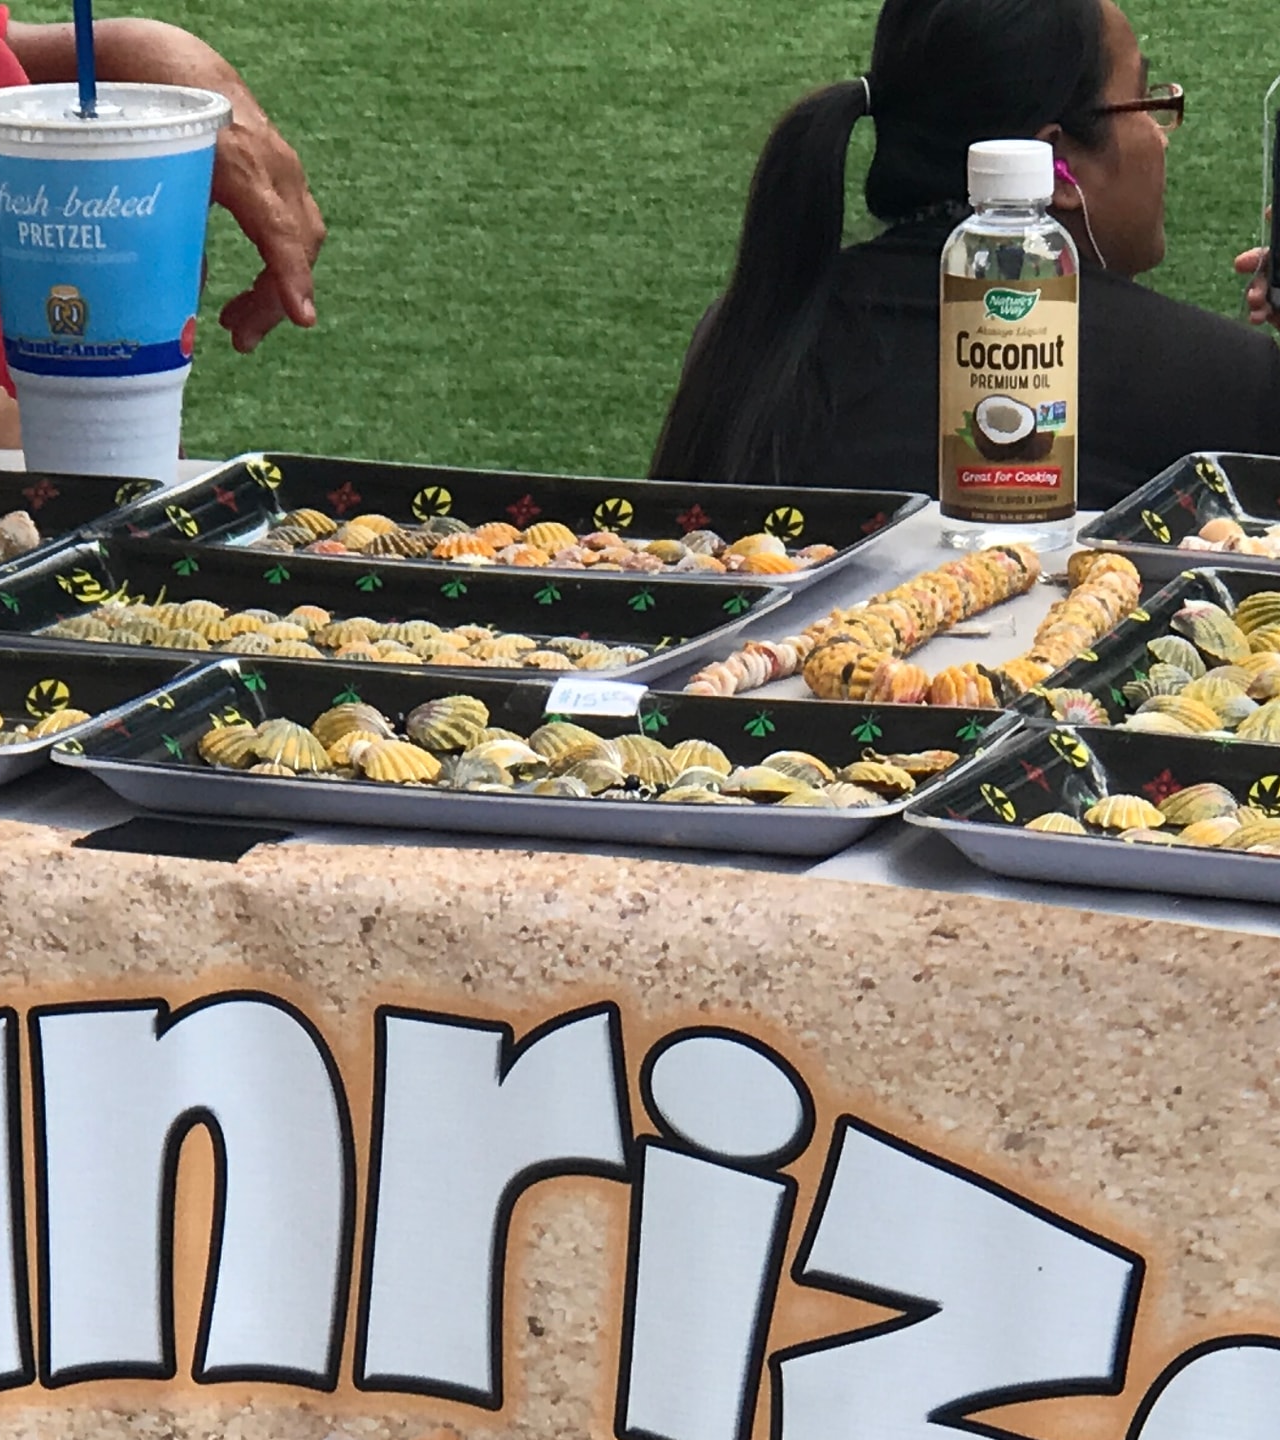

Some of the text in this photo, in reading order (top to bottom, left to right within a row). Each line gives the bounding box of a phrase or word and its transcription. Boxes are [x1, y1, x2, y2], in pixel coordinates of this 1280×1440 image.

[62, 181, 163, 218] baked
[18, 221, 107, 249] PRETZEL
[957, 330, 1064, 370] Coconut
[970, 373, 1050, 389] PREMIUM OIL
[962, 471, 1058, 486] Great for Cooking
